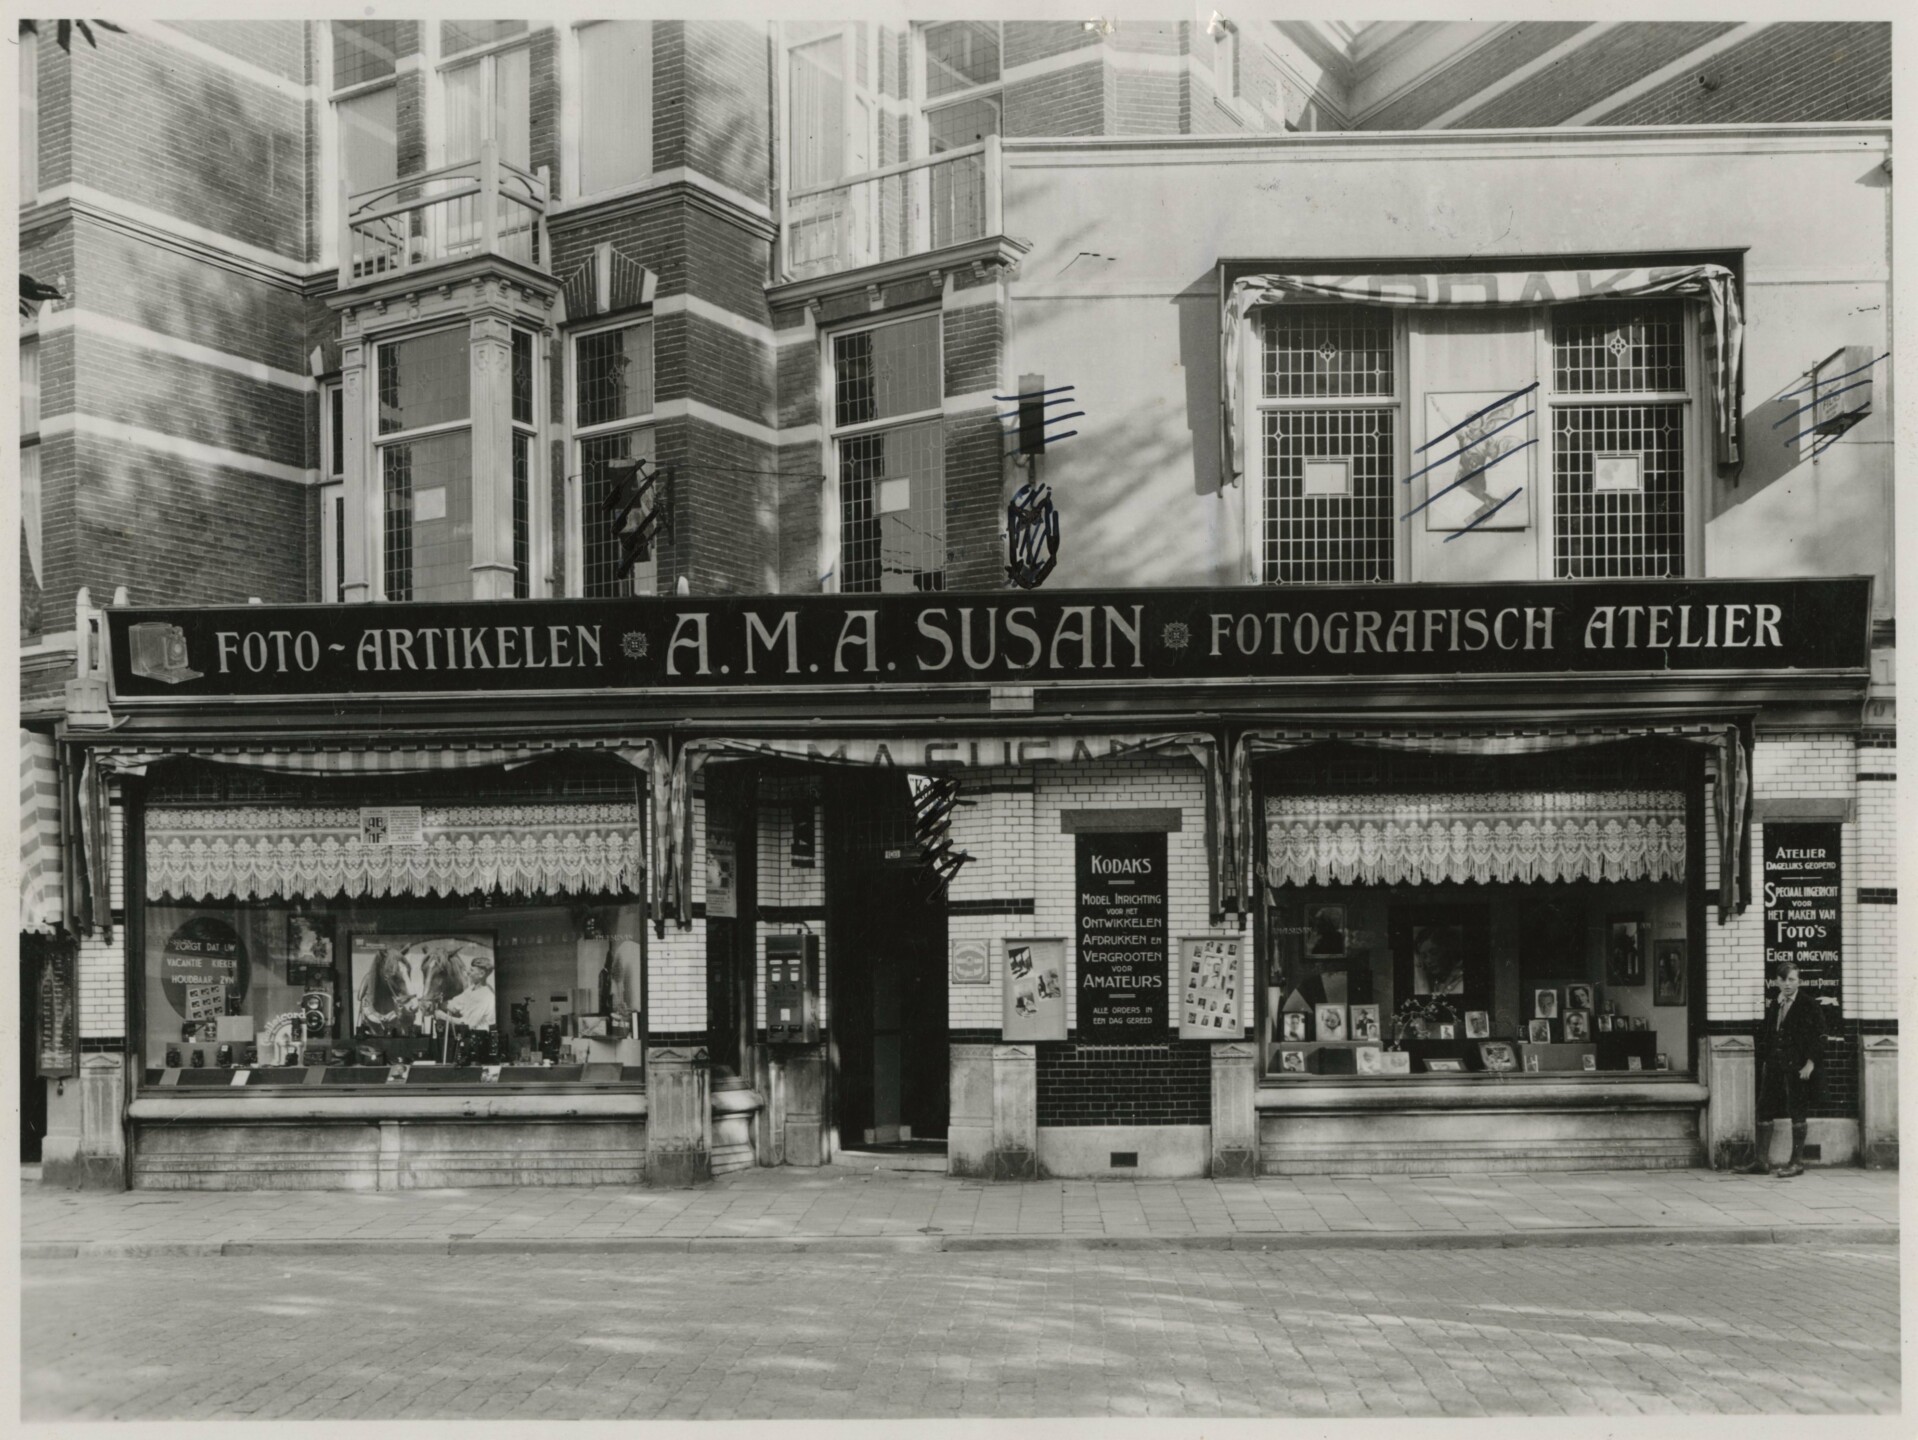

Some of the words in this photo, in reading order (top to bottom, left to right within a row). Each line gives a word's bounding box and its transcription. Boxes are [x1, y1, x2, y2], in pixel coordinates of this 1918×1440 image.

[1209, 606, 1556, 656] FOTOGRAFISCH
[1584, 604, 1783, 649] ATELIER
[917, 604, 1145, 671] SUSAN
[216, 631, 320, 673] FOTO
[356, 625, 603, 671] ARTIKELEN
[1775, 846, 1826, 859] ATELIER
[1091, 854, 1152, 874] KODAKS
[1804, 862, 1836, 870] GEOPEND
[1082, 893, 1111, 905] MODEL
[1114, 892, 1162, 905] INRICHTING
[1106, 907, 1124, 915] VOOR
[1767, 909, 1784, 921] HET
[1787, 909, 1817, 920] MAKEN
[1818, 909, 1836, 920] VAN
[1082, 916, 1162, 929] ONTWIKKELEN
[1777, 921, 1827, 943] FOTO'S
[1082, 933, 1147, 946] AFDRUKKEN
[1150, 936, 1162, 945] EN
[174, 942, 202, 951] ZORGT
[206, 943, 220, 951] DAT
[1082, 950, 1162, 963] VERGROOTEN
[1766, 948, 1794, 962] EIGEN
[1796, 950, 1839, 962] OMGEVING
[166, 958, 203, 968] VACANTIE
[211, 959, 237, 969] KIEKEN
[1111, 965, 1133, 973] VOOR
[171, 975, 213, 984] HOUDBAAR
[1083, 973, 1162, 988] AMATEURS
[1093, 1006, 1109, 1014] ALLE
[1112, 1006, 1141, 1014] ORDERS
[1093, 1017, 1106, 1025] EEN
[1108, 1017, 1124, 1025] DAG
[1126, 1017, 1153, 1025] GEREED
